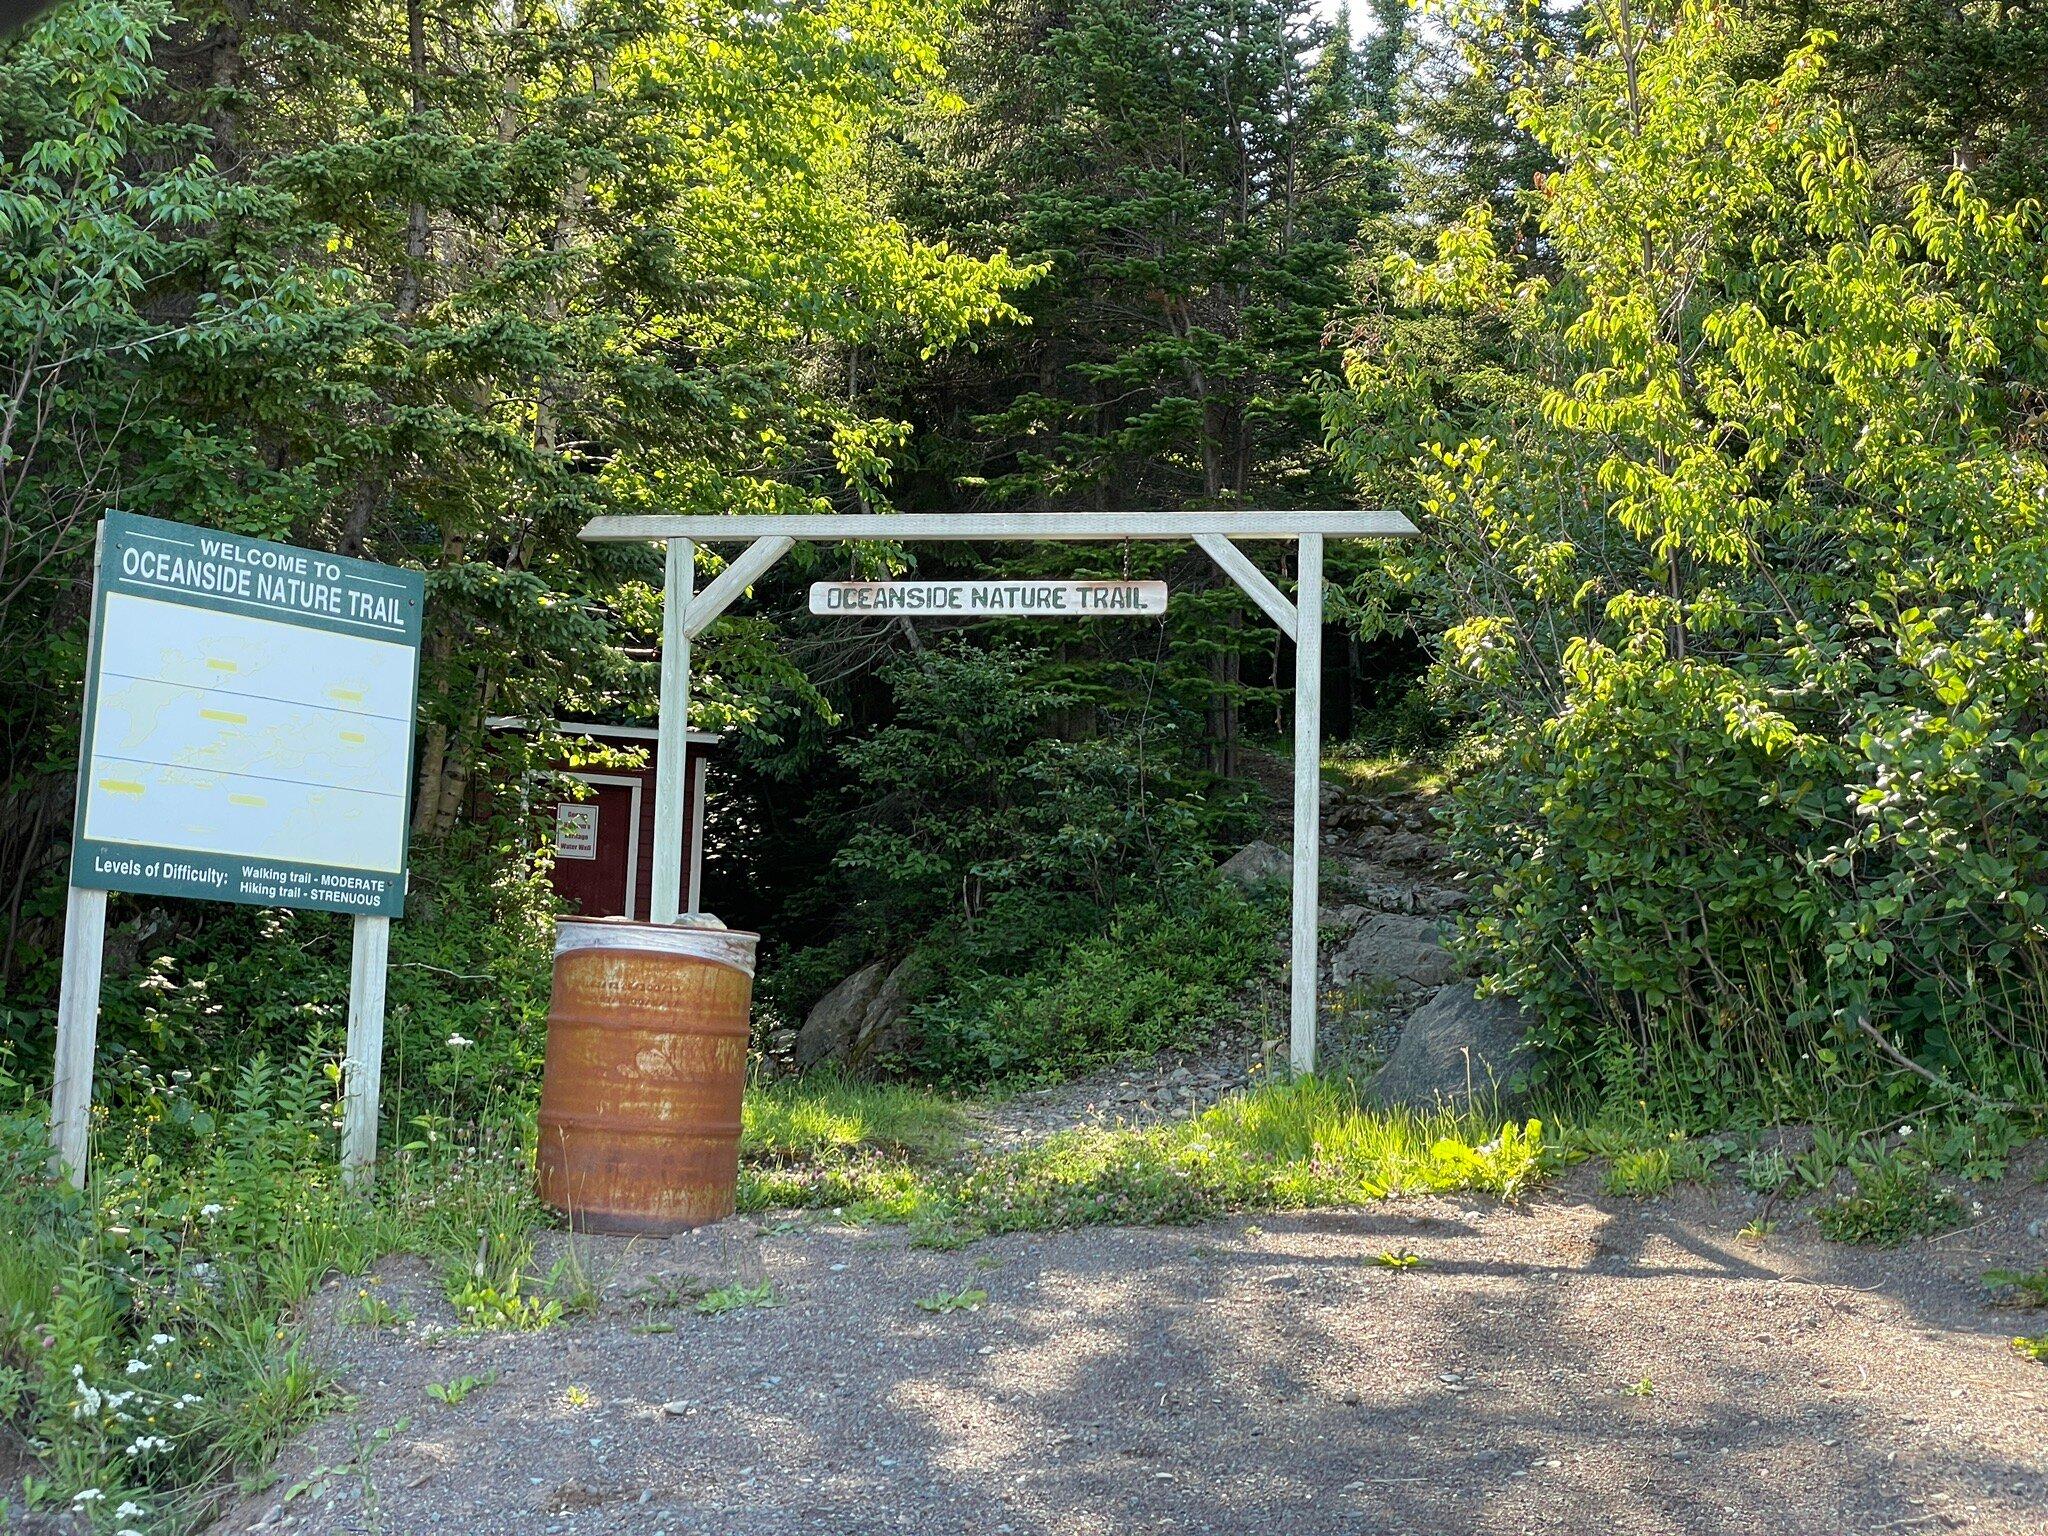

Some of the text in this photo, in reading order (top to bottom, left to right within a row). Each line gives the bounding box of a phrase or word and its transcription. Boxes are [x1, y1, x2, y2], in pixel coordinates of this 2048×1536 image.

[200, 538, 341, 581] WELCOME TO
[122, 546, 405, 626] OCEANSIDE NATURE TRAIL
[827, 587, 1148, 609] OCEANSIDE NATURE TRAIL
[94, 856, 229, 888] Levels of Difficulty:
[241, 865, 287, 885] Walking
[290, 870, 311, 884] trail
[320, 874, 385, 892] MODERATE
[239, 881, 276, 899] Hiking
[279, 885, 301, 899] trail
[310, 888, 381, 908] STRENUOUS
